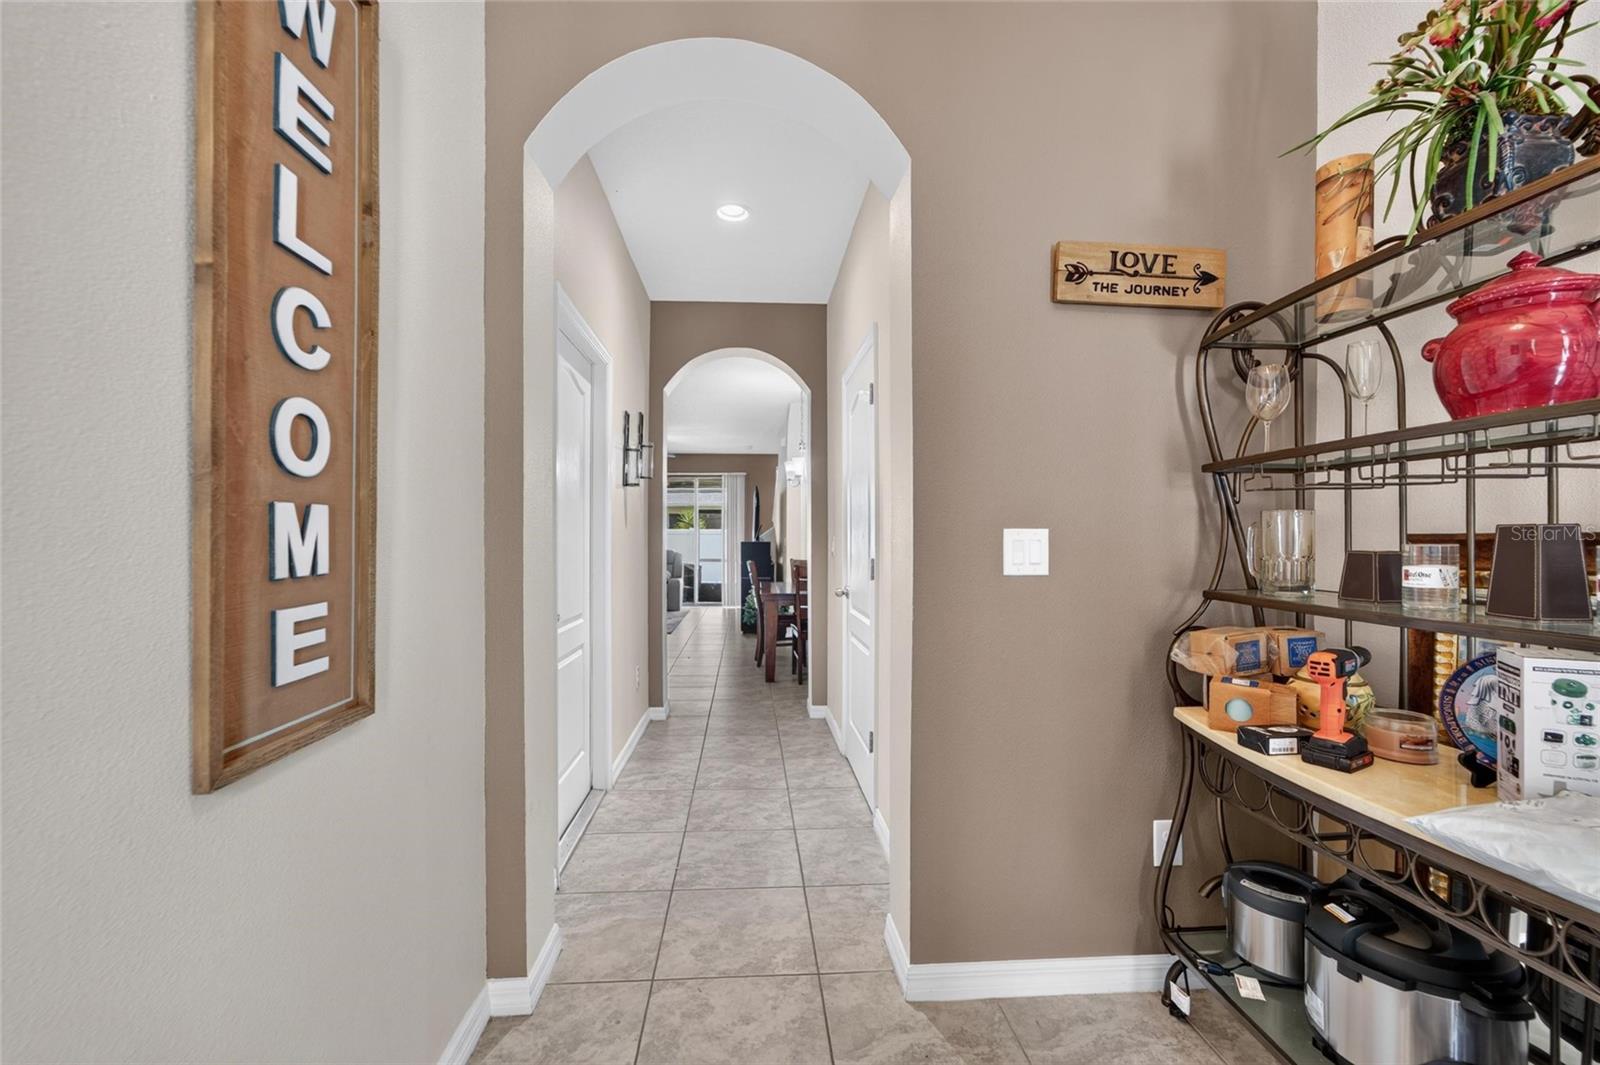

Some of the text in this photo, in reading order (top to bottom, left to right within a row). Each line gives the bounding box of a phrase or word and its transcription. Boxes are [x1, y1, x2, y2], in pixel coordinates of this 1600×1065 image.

[1109, 250, 1178, 277] LOVE
[1092, 282, 1189, 297] THE JOURNEY
[271, 0, 337, 687] WELCOME
